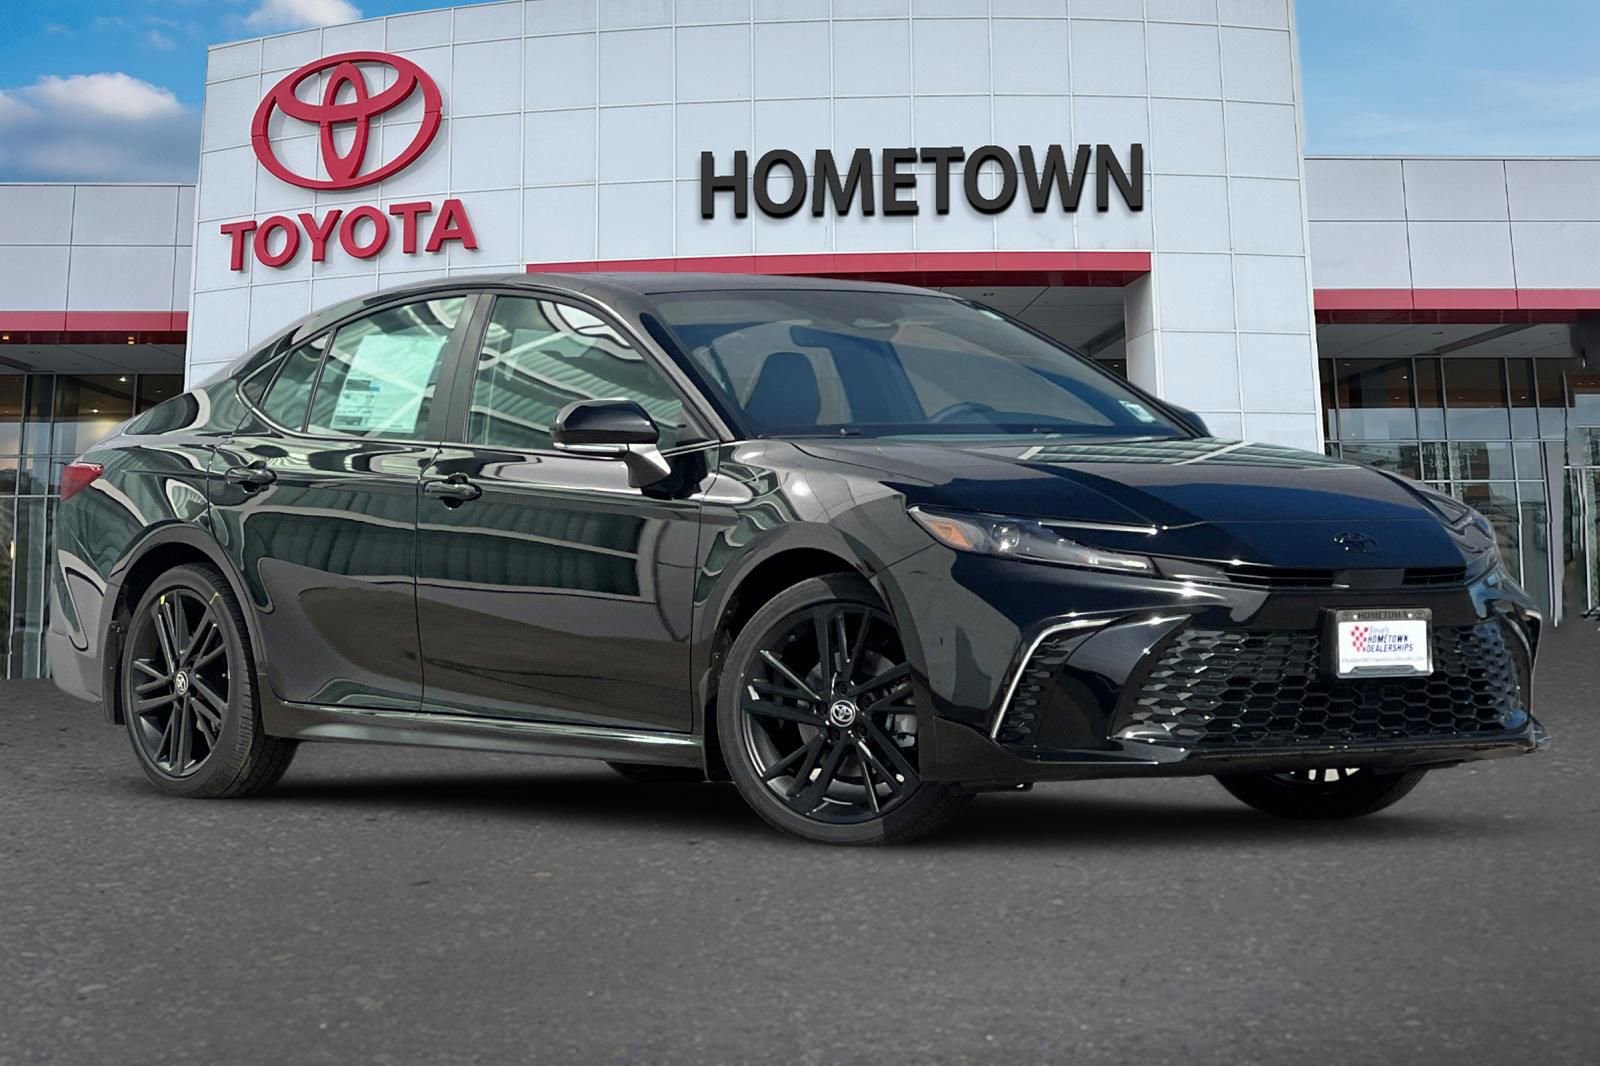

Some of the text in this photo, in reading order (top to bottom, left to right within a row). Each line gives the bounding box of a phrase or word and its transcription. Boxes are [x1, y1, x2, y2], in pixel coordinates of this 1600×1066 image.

[700, 143, 1144, 219] HOMETOWN
[220, 198, 479, 271] TOYOTA
[1366, 644, 1413, 652] DEALERSHIPS
[1367, 635, 1408, 643] HOMETOWN
